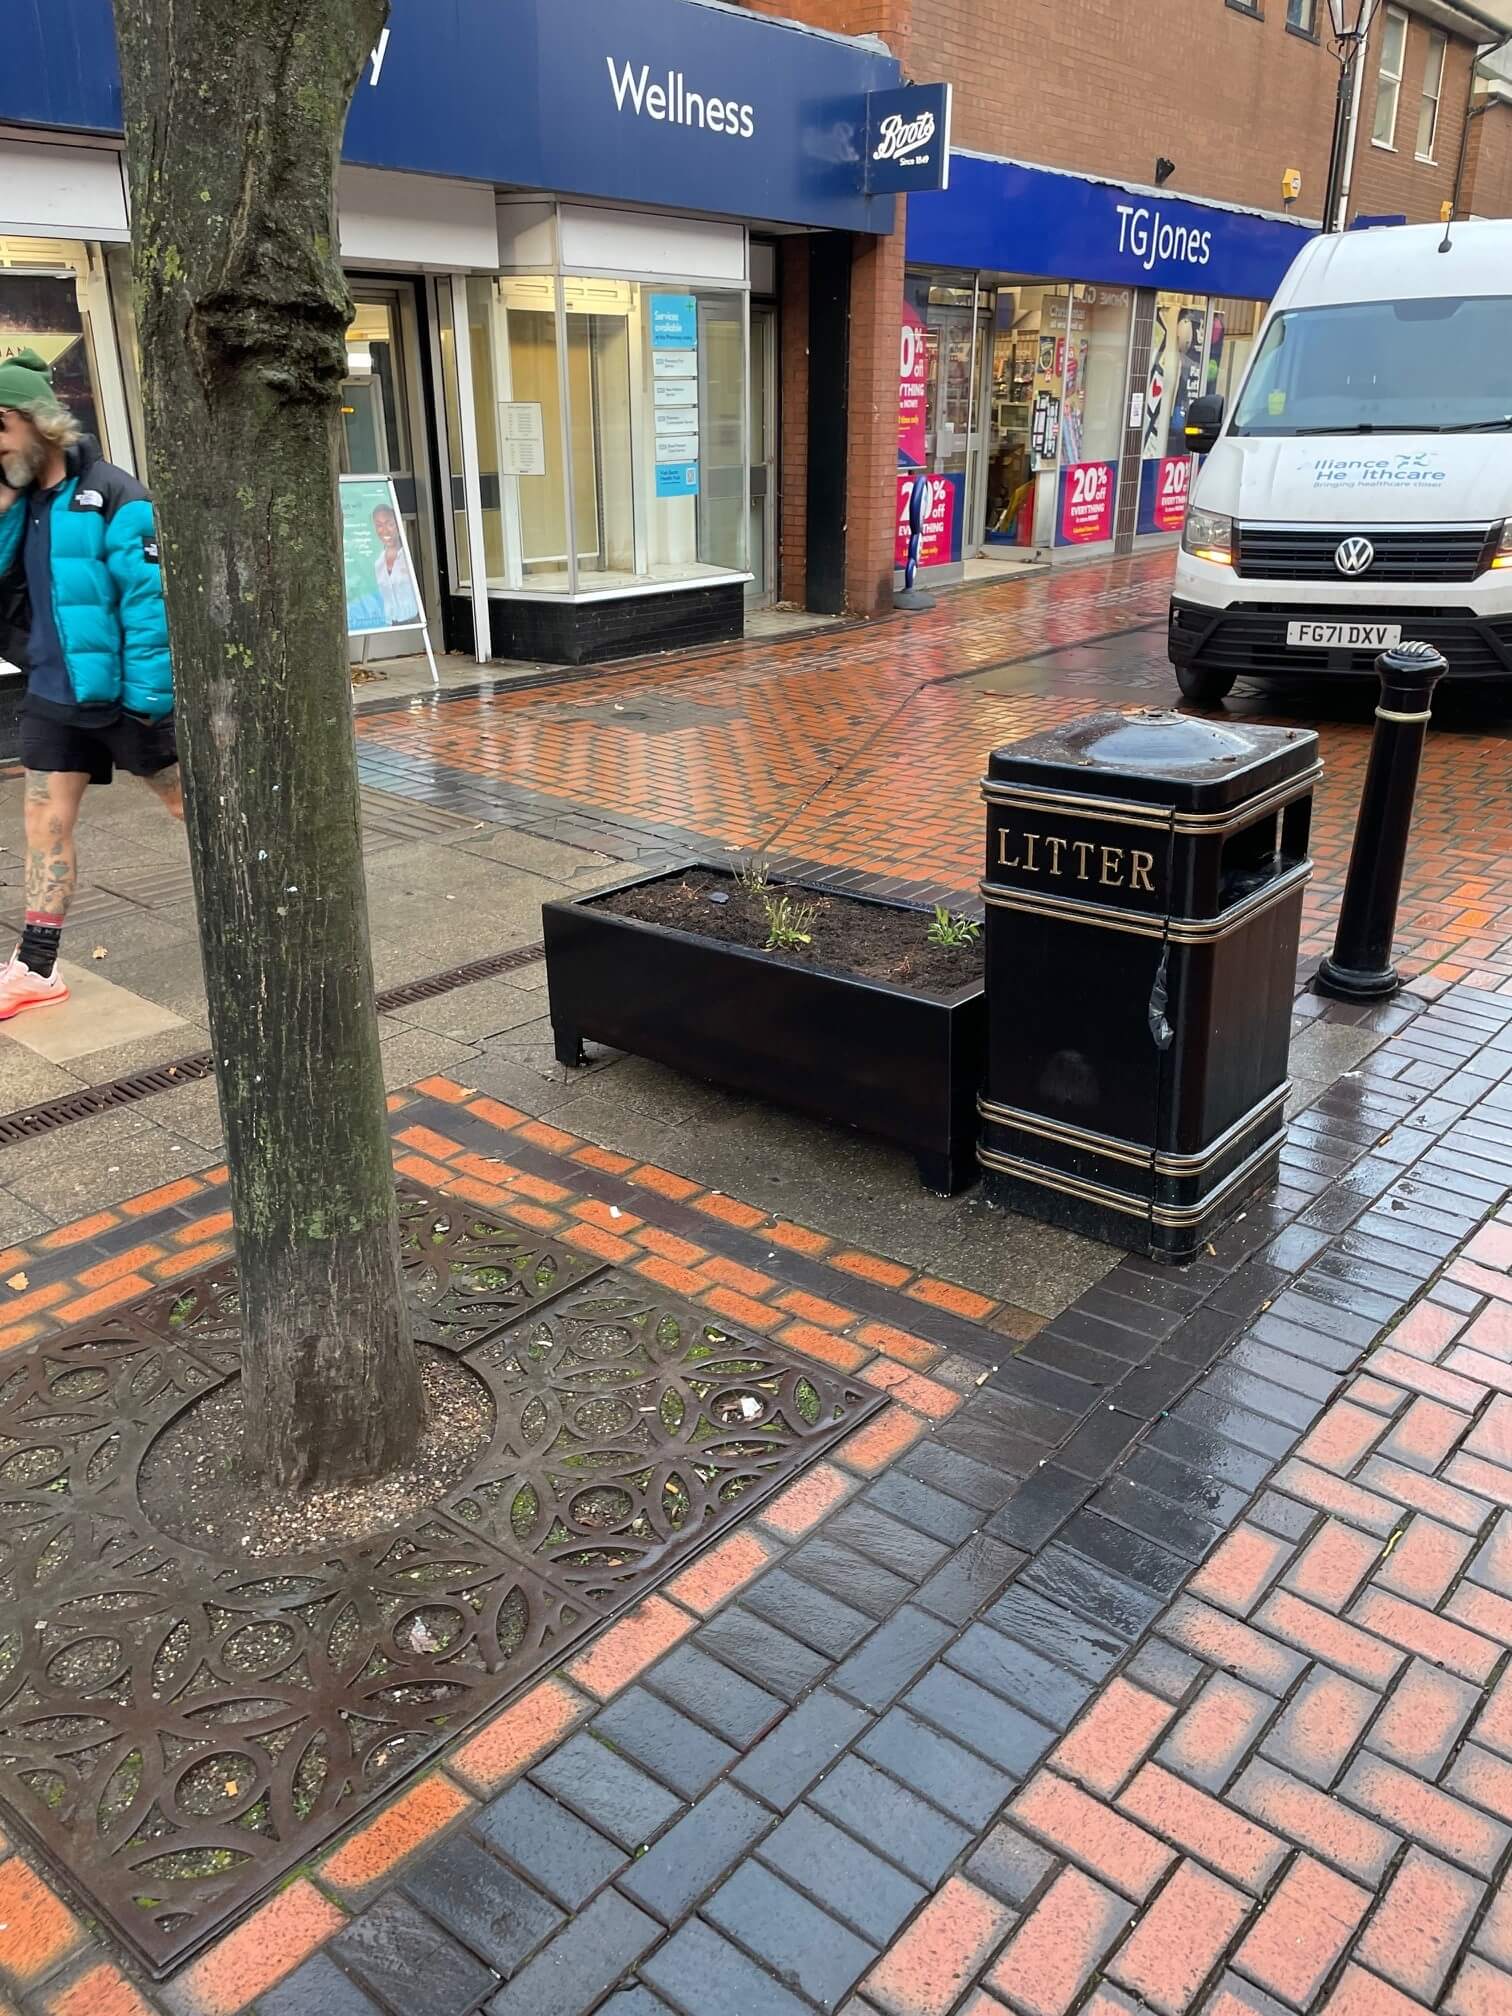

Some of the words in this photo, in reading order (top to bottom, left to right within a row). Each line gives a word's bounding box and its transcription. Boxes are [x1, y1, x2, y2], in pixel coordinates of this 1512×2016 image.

[605, 56, 754, 138] Wellness
[873, 111, 935, 160] Boots
[899, 157, 915, 167] Since
[1313, 459, 1390, 470] lliance
[1071, 465, 1108, 504] 20%
[1313, 481, 1355, 489] Bringing
[1357, 480, 1411, 488] healthcare
[1095, 486, 1107, 501] off
[932, 503, 945, 519] off
[1071, 503, 1106, 517] EVERYTHING
[1298, 625, 1345, 643] FG71
[1348, 626, 1388, 644] DXV
[997, 827, 1156, 892] LITTER
